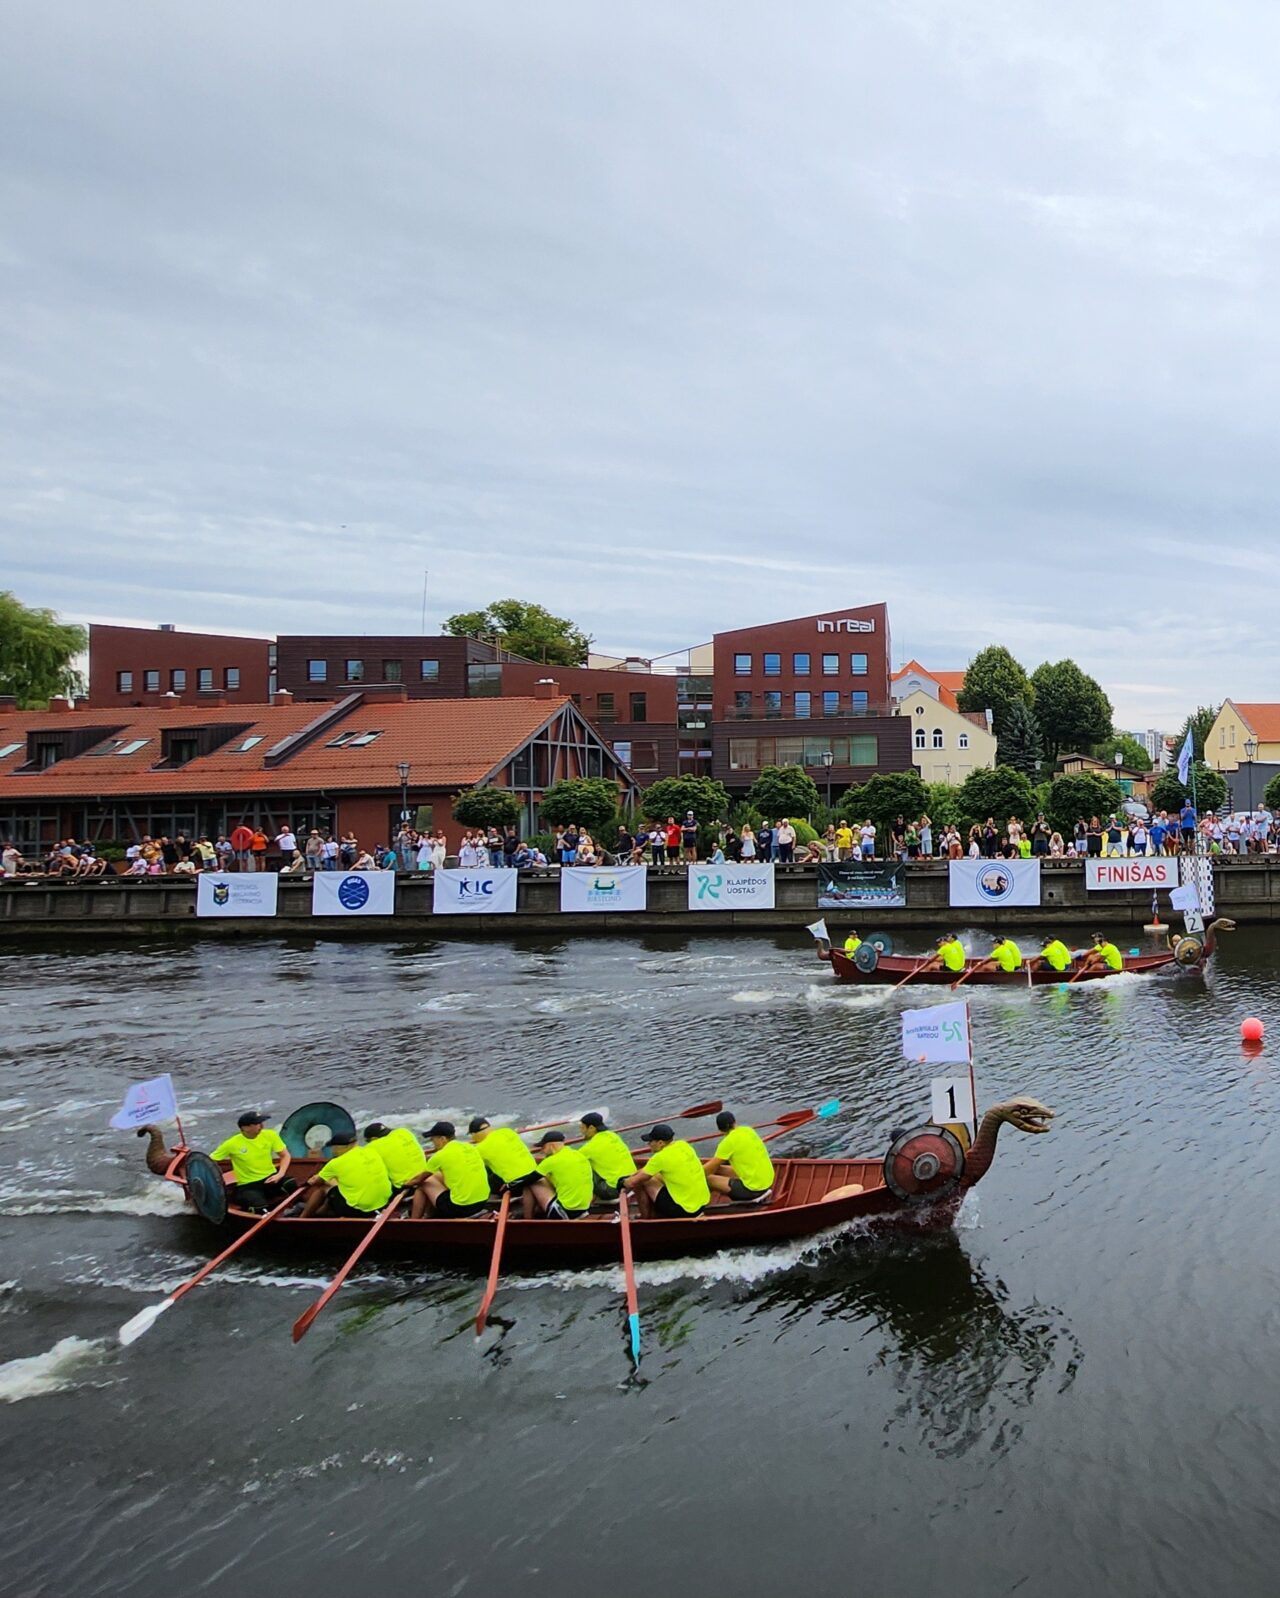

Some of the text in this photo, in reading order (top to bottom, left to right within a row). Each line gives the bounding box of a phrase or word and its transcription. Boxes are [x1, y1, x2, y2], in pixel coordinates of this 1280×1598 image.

[1097, 861, 1167, 883] FINIŠAS
[459, 878, 493, 894] KIC
[726, 877, 767, 886] KLAIPĖDOS
[1187, 917, 1199, 932] 2
[944, 1084, 958, 1119] 1
